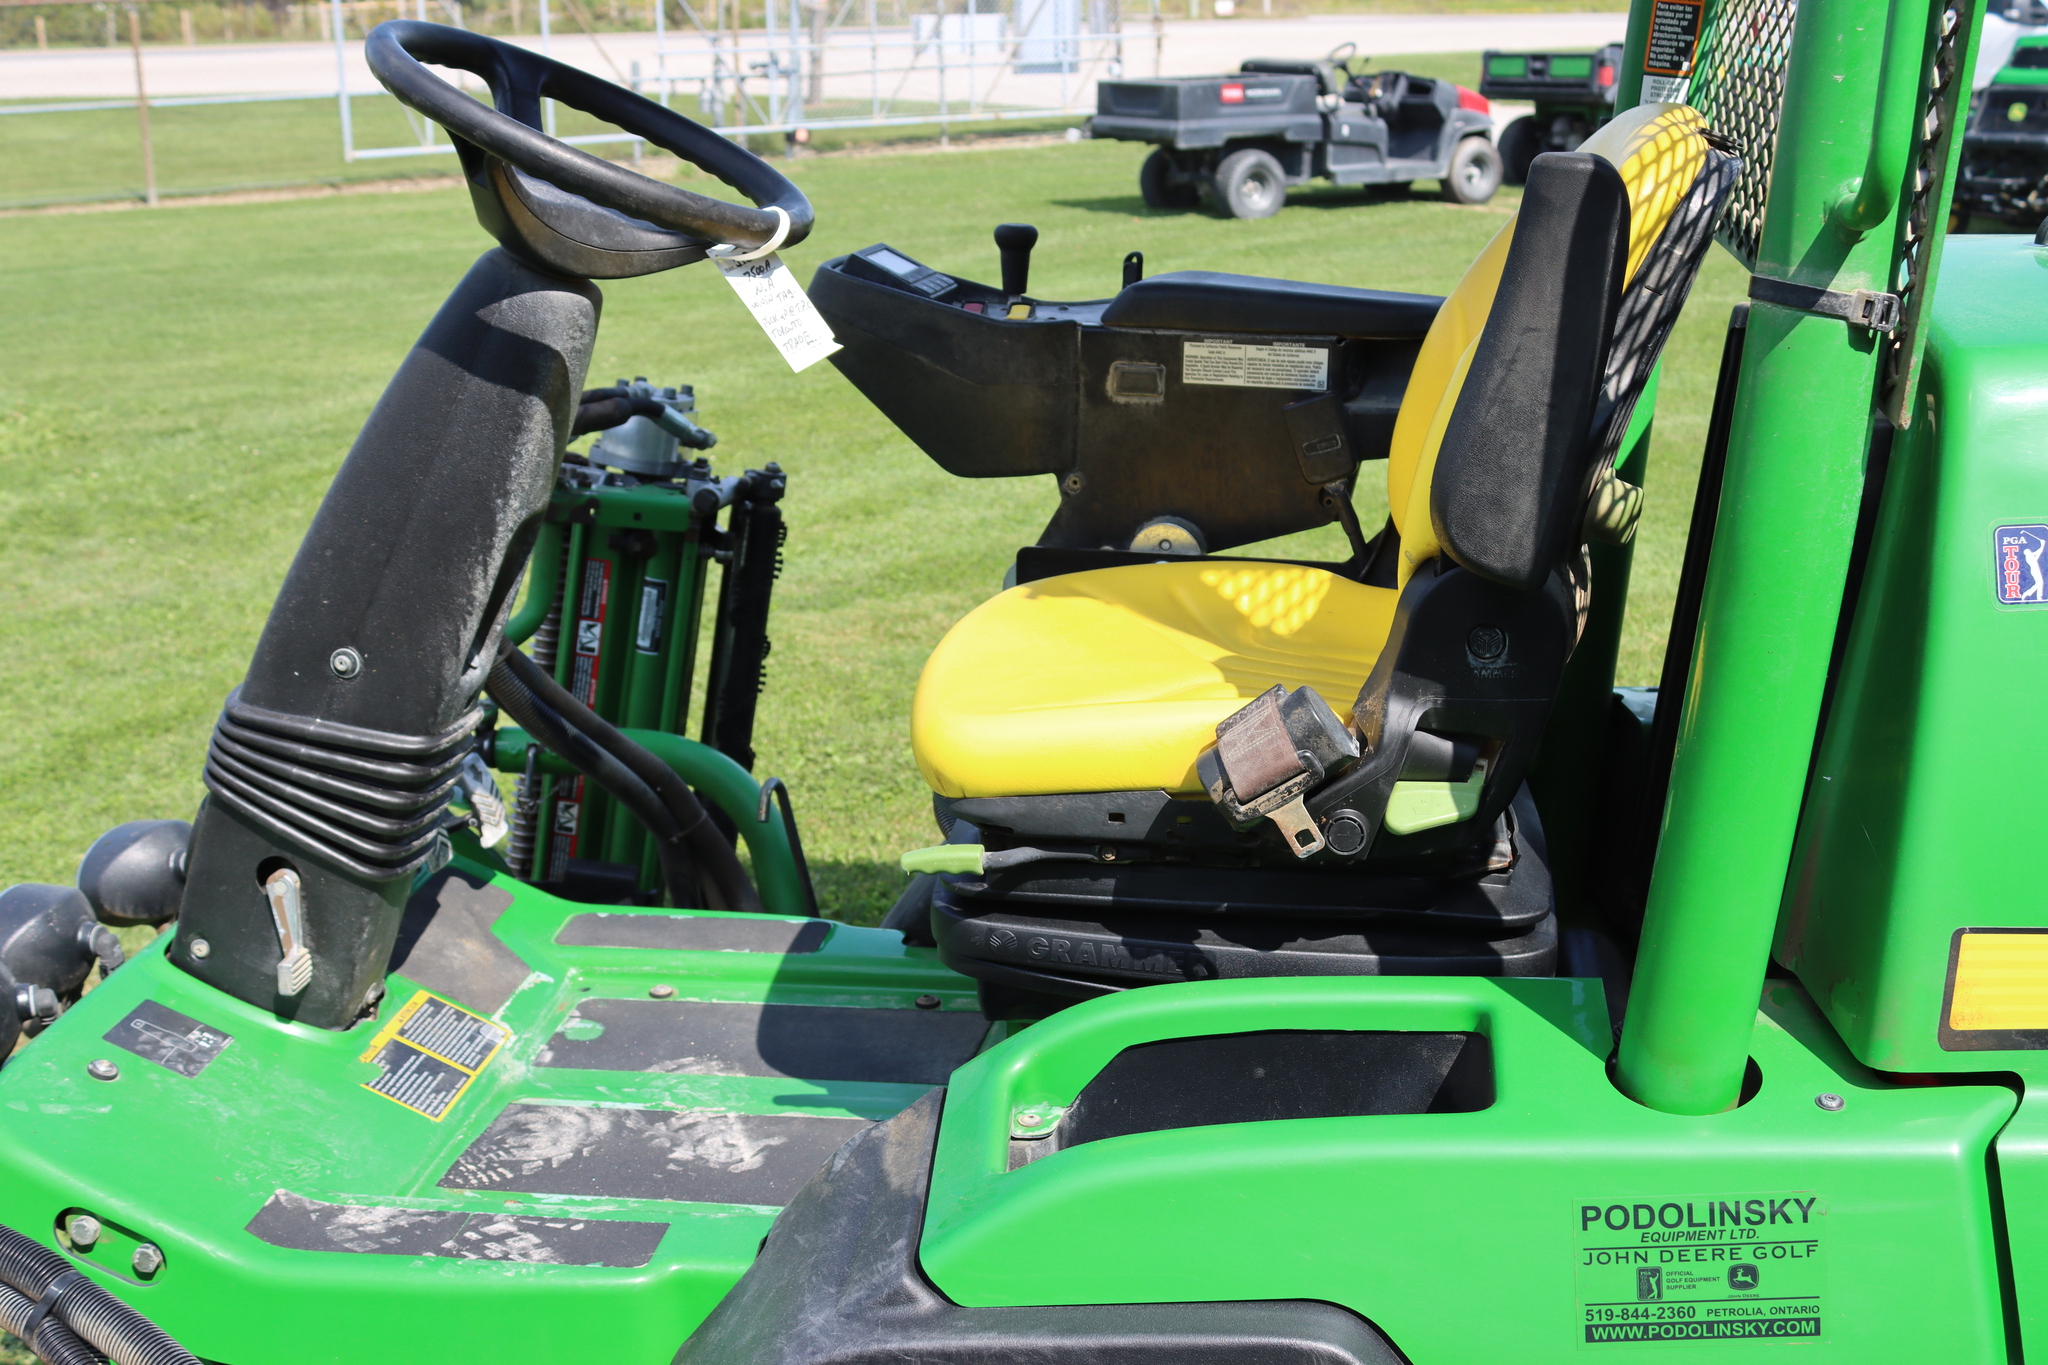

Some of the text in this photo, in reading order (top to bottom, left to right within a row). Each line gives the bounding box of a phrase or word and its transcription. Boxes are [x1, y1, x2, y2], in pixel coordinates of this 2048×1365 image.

[743, 259, 771, 282] 7500A
[2003, 546, 2021, 598] TOUR
[1026, 936, 1208, 977] GRAMMER
[1581, 1197, 1817, 1231] PODOLINSKY
[1640, 1228, 1760, 1243] EQUIPMENT LTD.
[1583, 1245, 1818, 1266] JOHN DEERE GOLF
[1585, 1305, 1820, 1321] 519-844-2360 PETROLIA, ONTARIO
[1592, 1320, 1816, 1340] WWW.PODOLINSKY.COM
